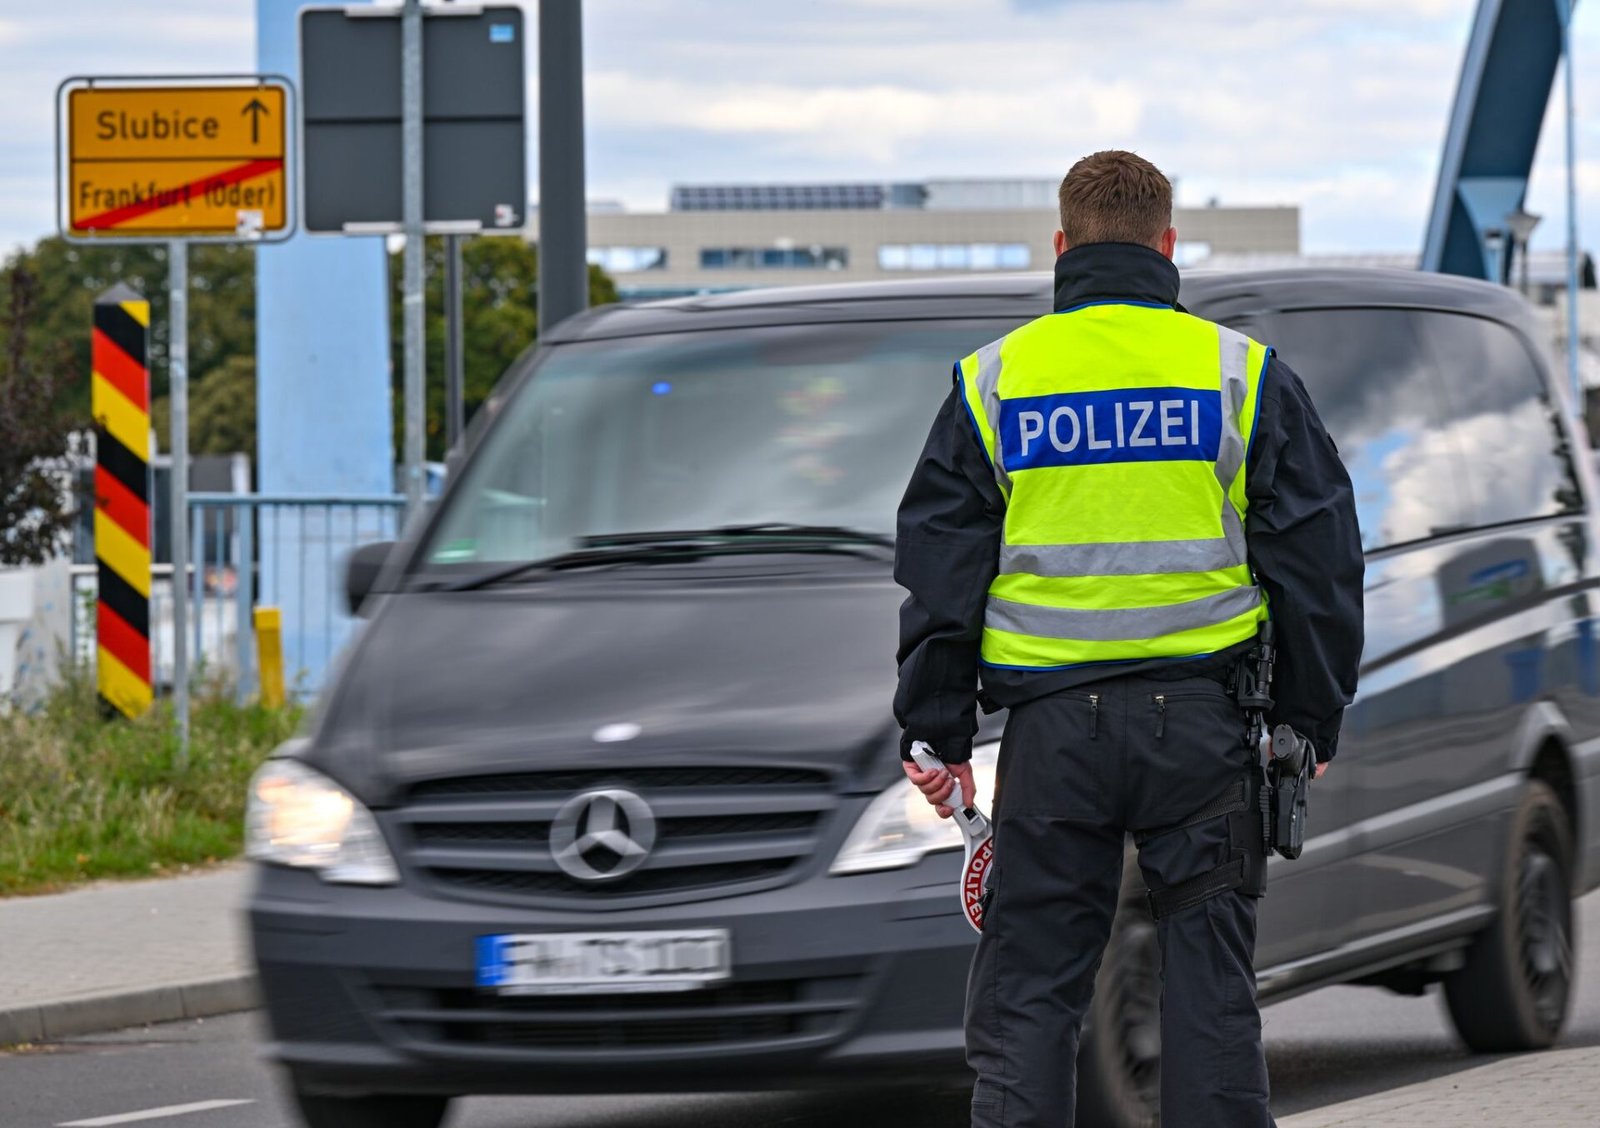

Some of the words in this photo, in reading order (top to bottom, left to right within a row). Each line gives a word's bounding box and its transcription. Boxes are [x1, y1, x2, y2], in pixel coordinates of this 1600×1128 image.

[96, 110, 220, 140] Slubice
[79, 180, 192, 209] Frankfurt
[204, 179, 275, 207] (Oder)
[1018, 399, 1200, 457] POLIZEI
